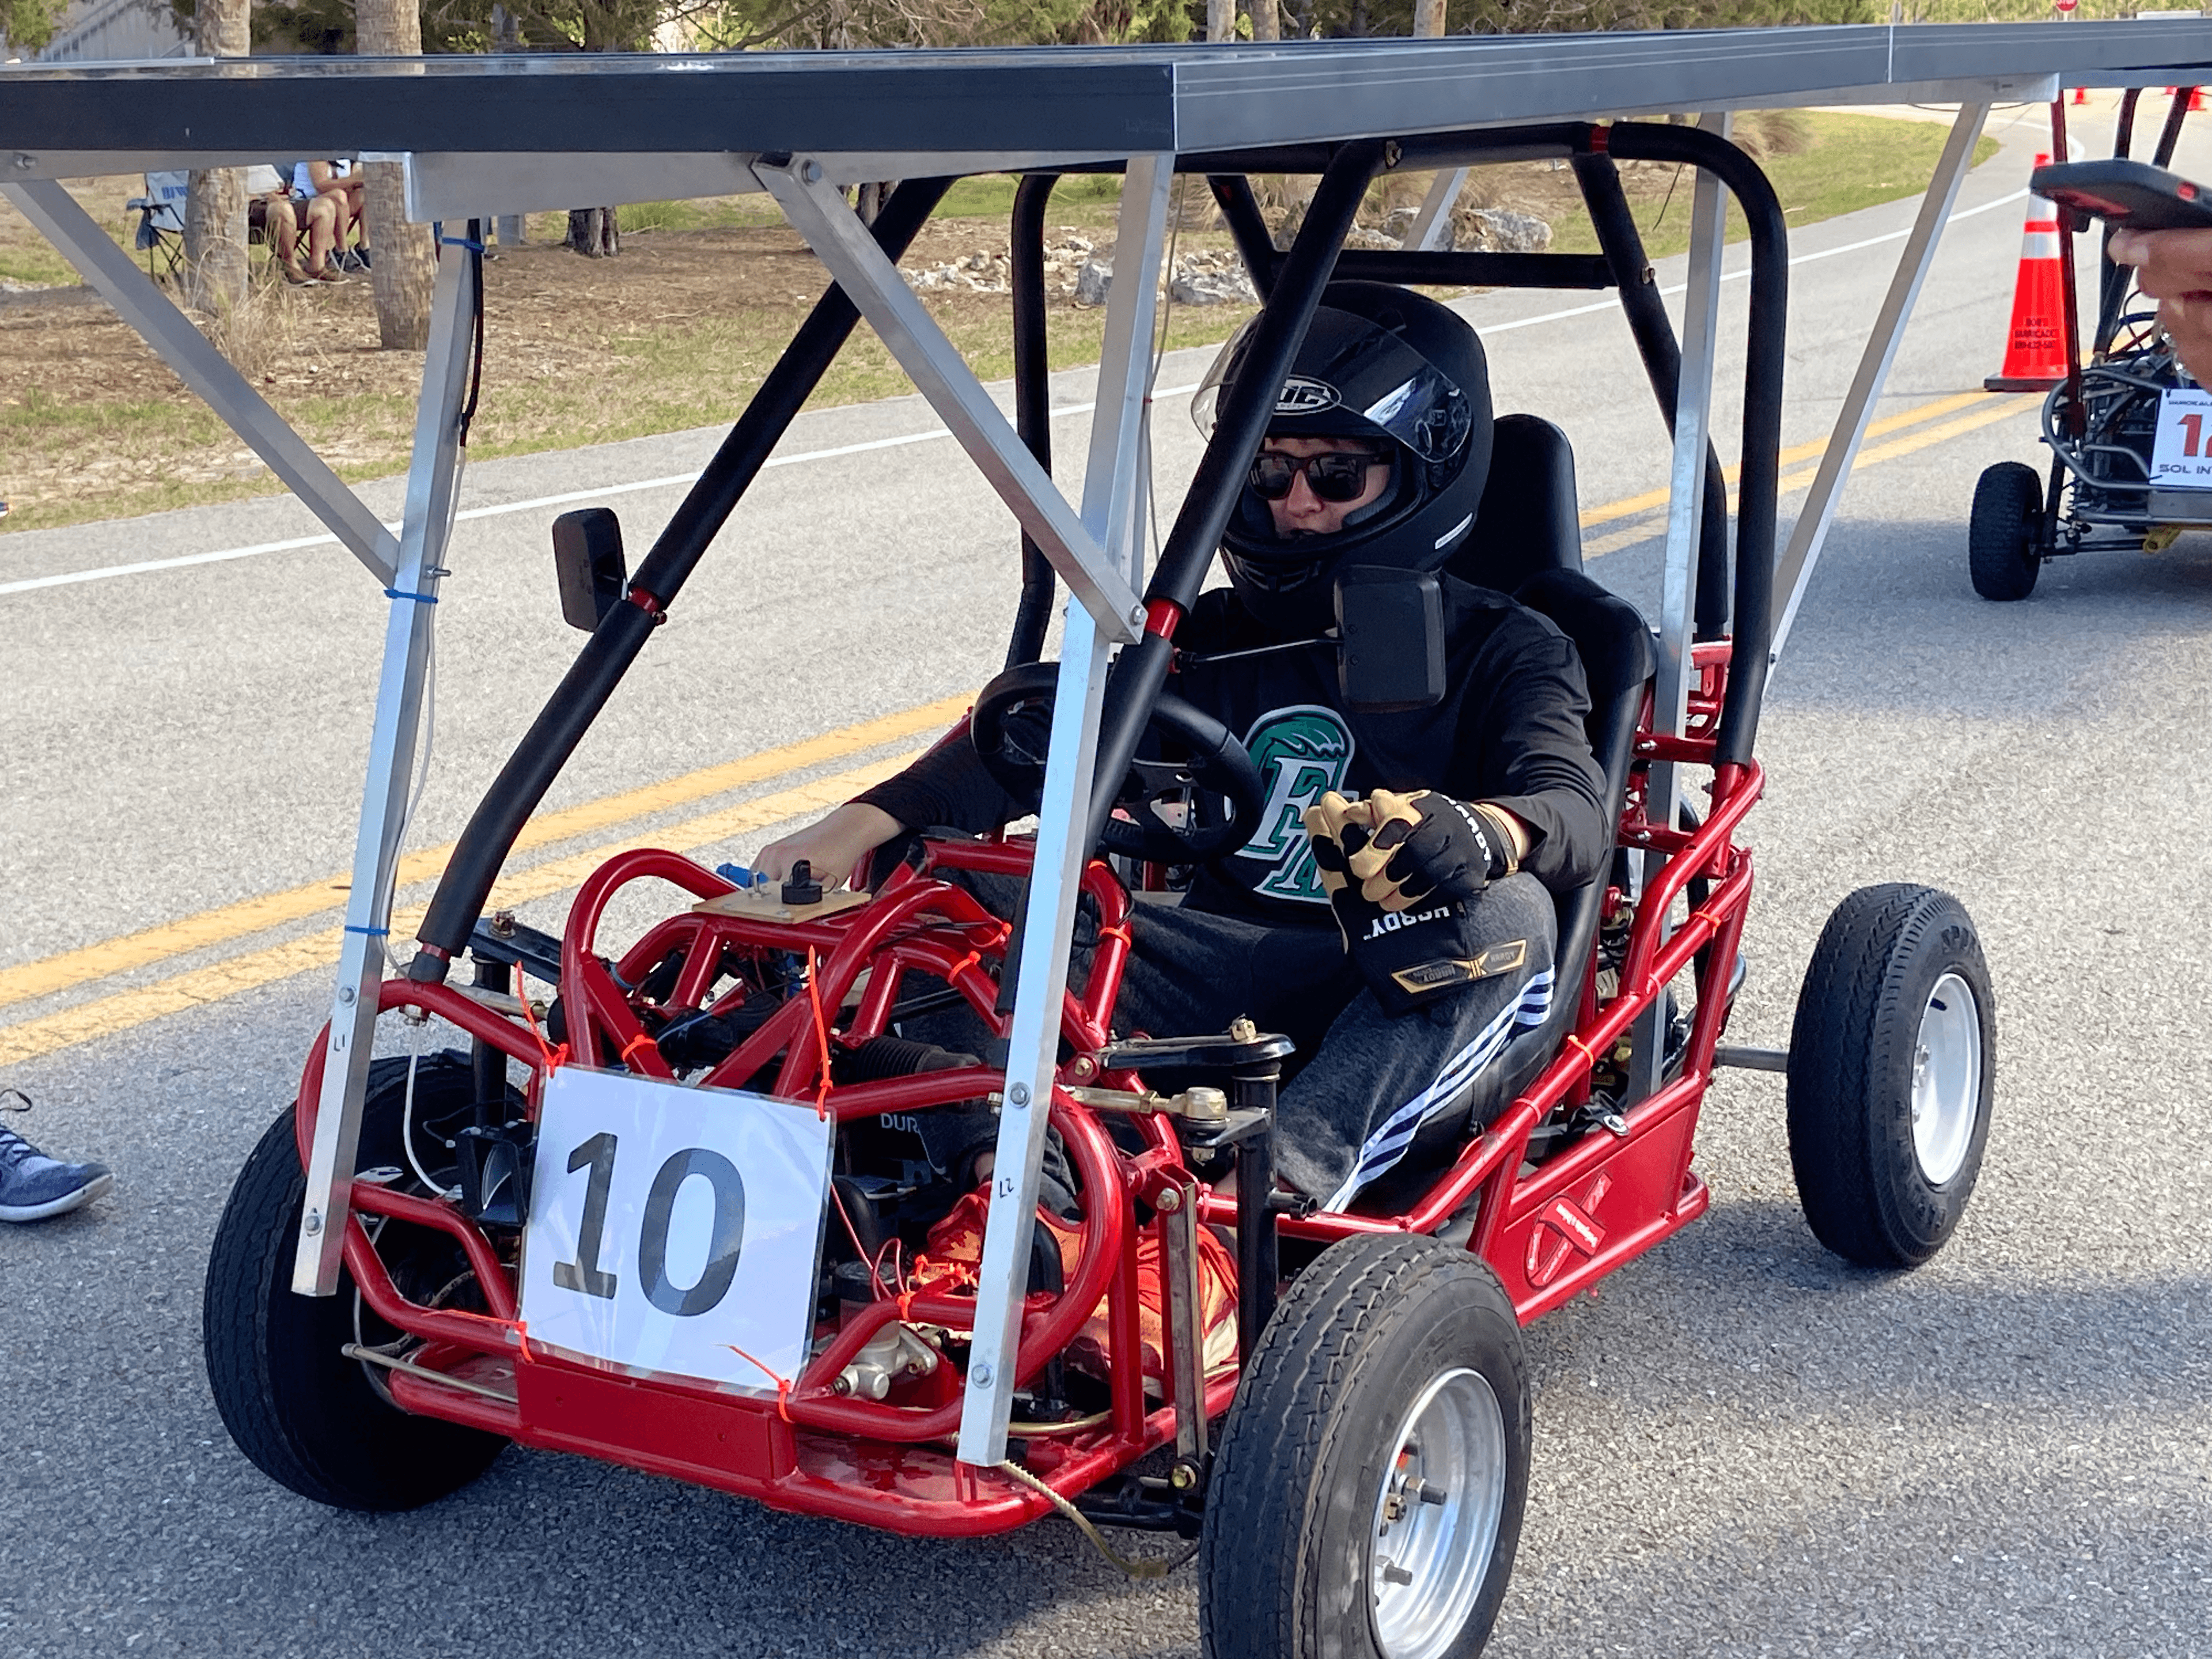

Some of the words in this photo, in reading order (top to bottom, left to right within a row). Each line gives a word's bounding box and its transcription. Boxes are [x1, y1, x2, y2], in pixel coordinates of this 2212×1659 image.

[1278, 383, 1328, 405] JC
[2159, 464, 2191, 474] SOL
[2196, 465, 2212, 475] IN
[880, 1112, 920, 1133] DUR
[999, 1177, 1015, 1199] L2
[553, 1131, 745, 1317] 10
